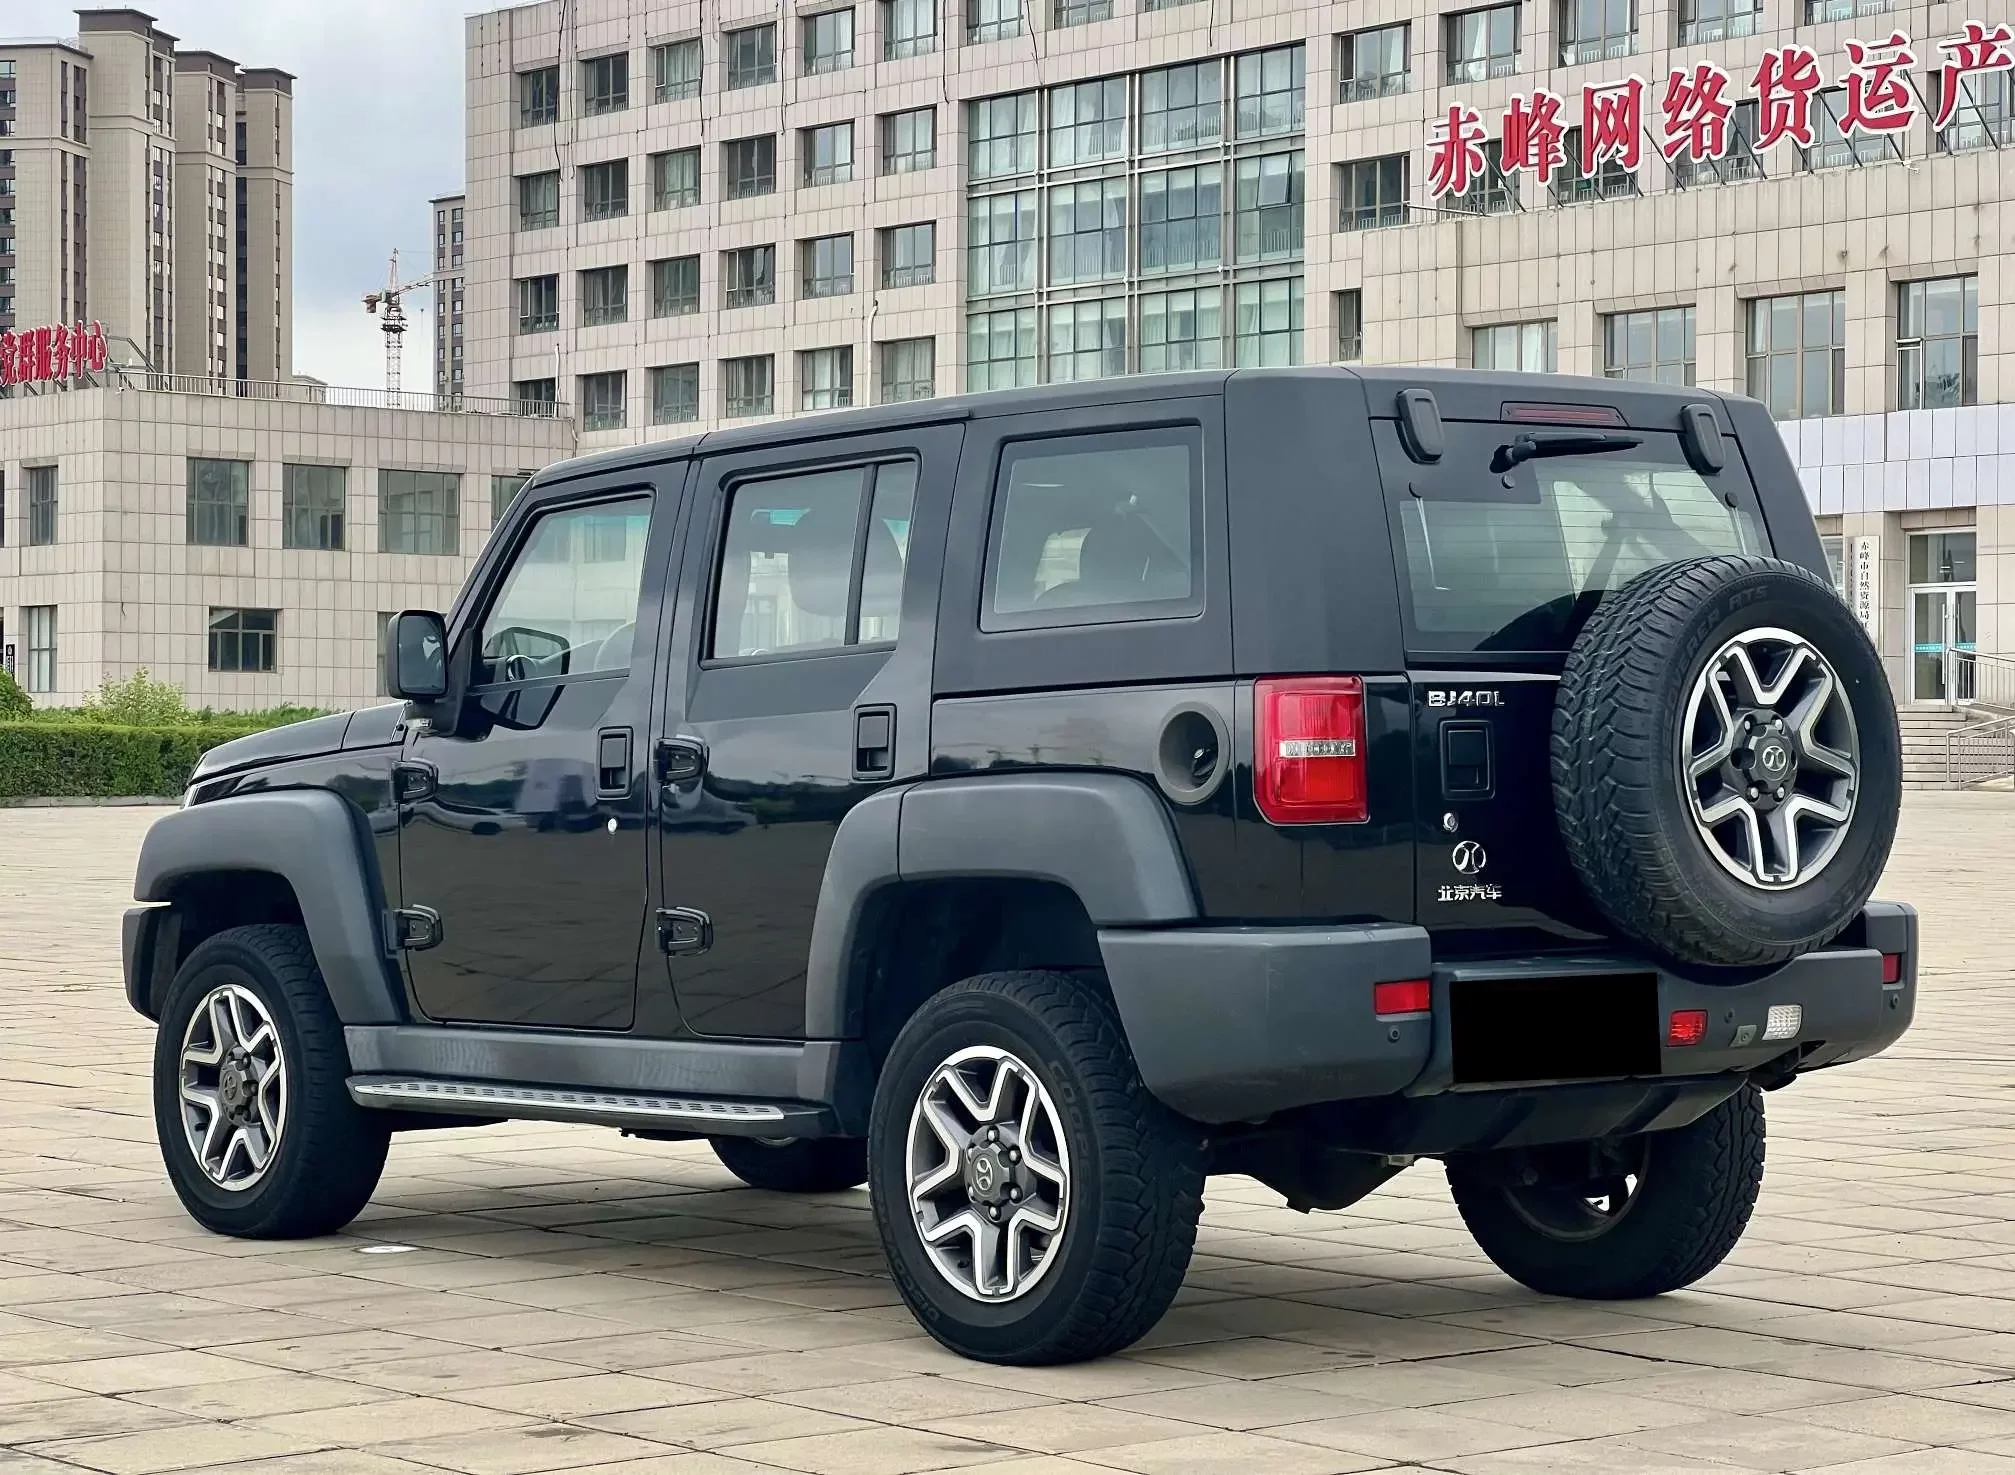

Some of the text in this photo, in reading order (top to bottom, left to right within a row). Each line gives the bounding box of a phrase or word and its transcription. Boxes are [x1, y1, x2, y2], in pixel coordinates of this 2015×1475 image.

[1426, 21, 2014, 197] 赤峰网络货运产
[1427, 690, 1505, 708] BJ40L
[1437, 883, 1503, 902] 北京汽车
